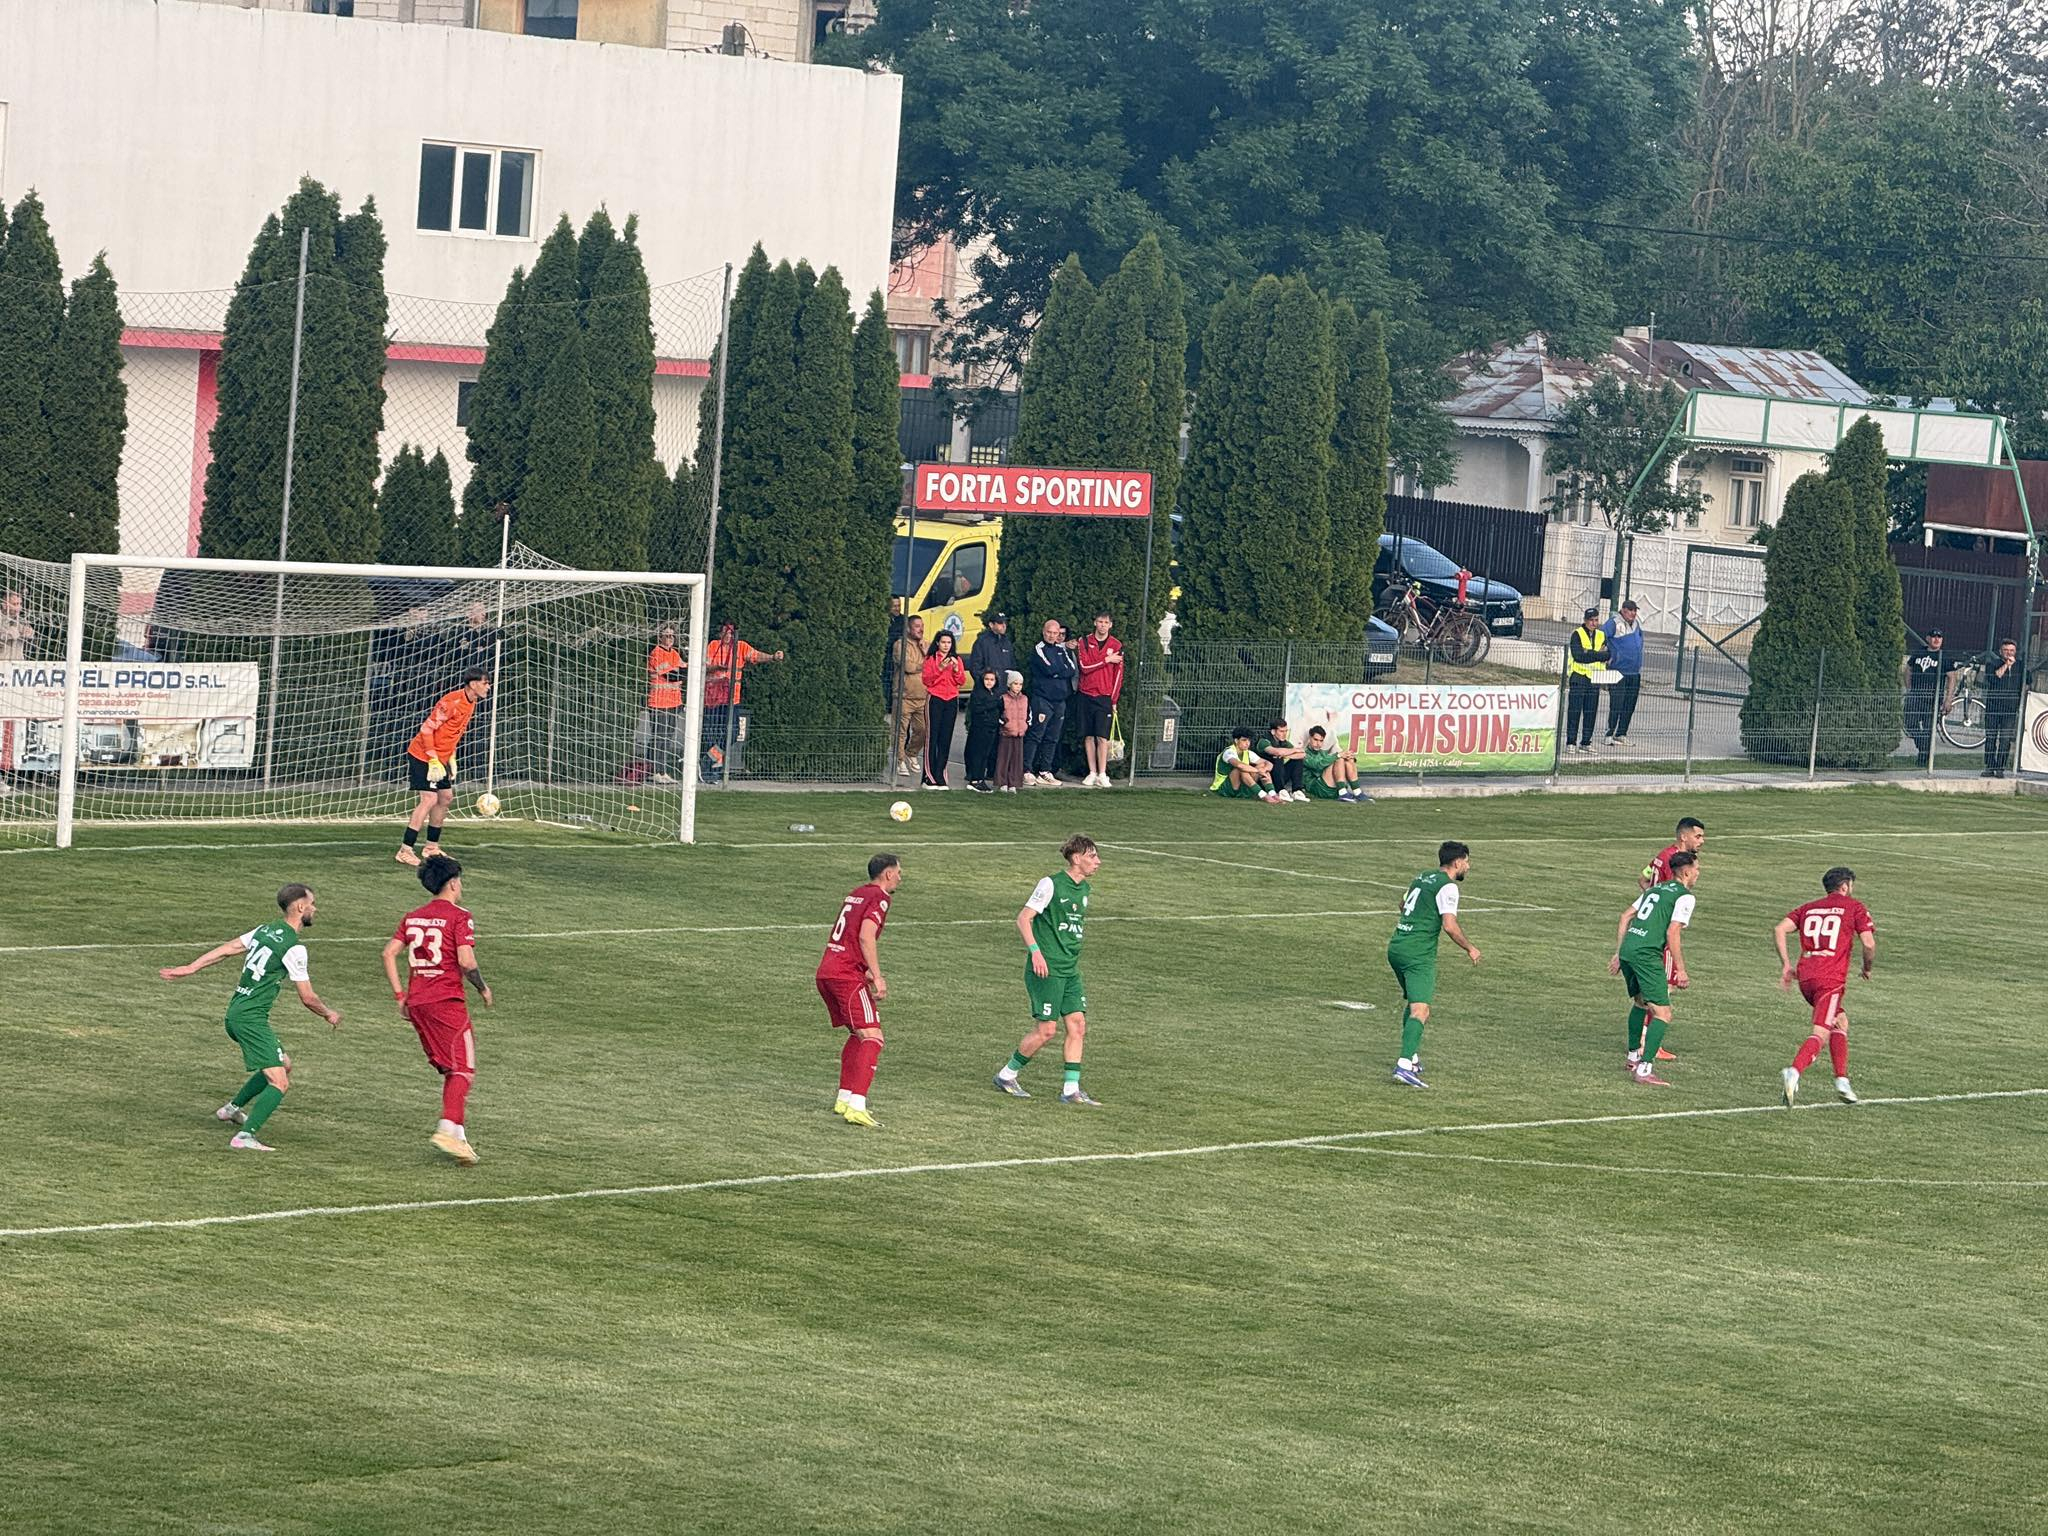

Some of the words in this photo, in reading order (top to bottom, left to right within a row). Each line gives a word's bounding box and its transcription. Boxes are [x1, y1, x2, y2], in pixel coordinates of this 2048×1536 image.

[926, 472, 1007, 503] FORTA
[1015, 476, 1143, 508] SPORTING
[12, 669, 109, 688] MAREL
[115, 670, 181, 689] PROD
[185, 674, 226, 689] S.R.L.
[1352, 692, 1442, 710] COMPLEX
[1447, 693, 1549, 710] ZOOTEHNIC
[1349, 714, 1510, 753] FERMSUIN
[1508, 734, 1544, 753] S.R.L.
[1637, 893, 1660, 921] 6
[405, 926, 443, 967] 23
[1803, 915, 1841, 950] 99
[1043, 1003, 1051, 1016] 5
